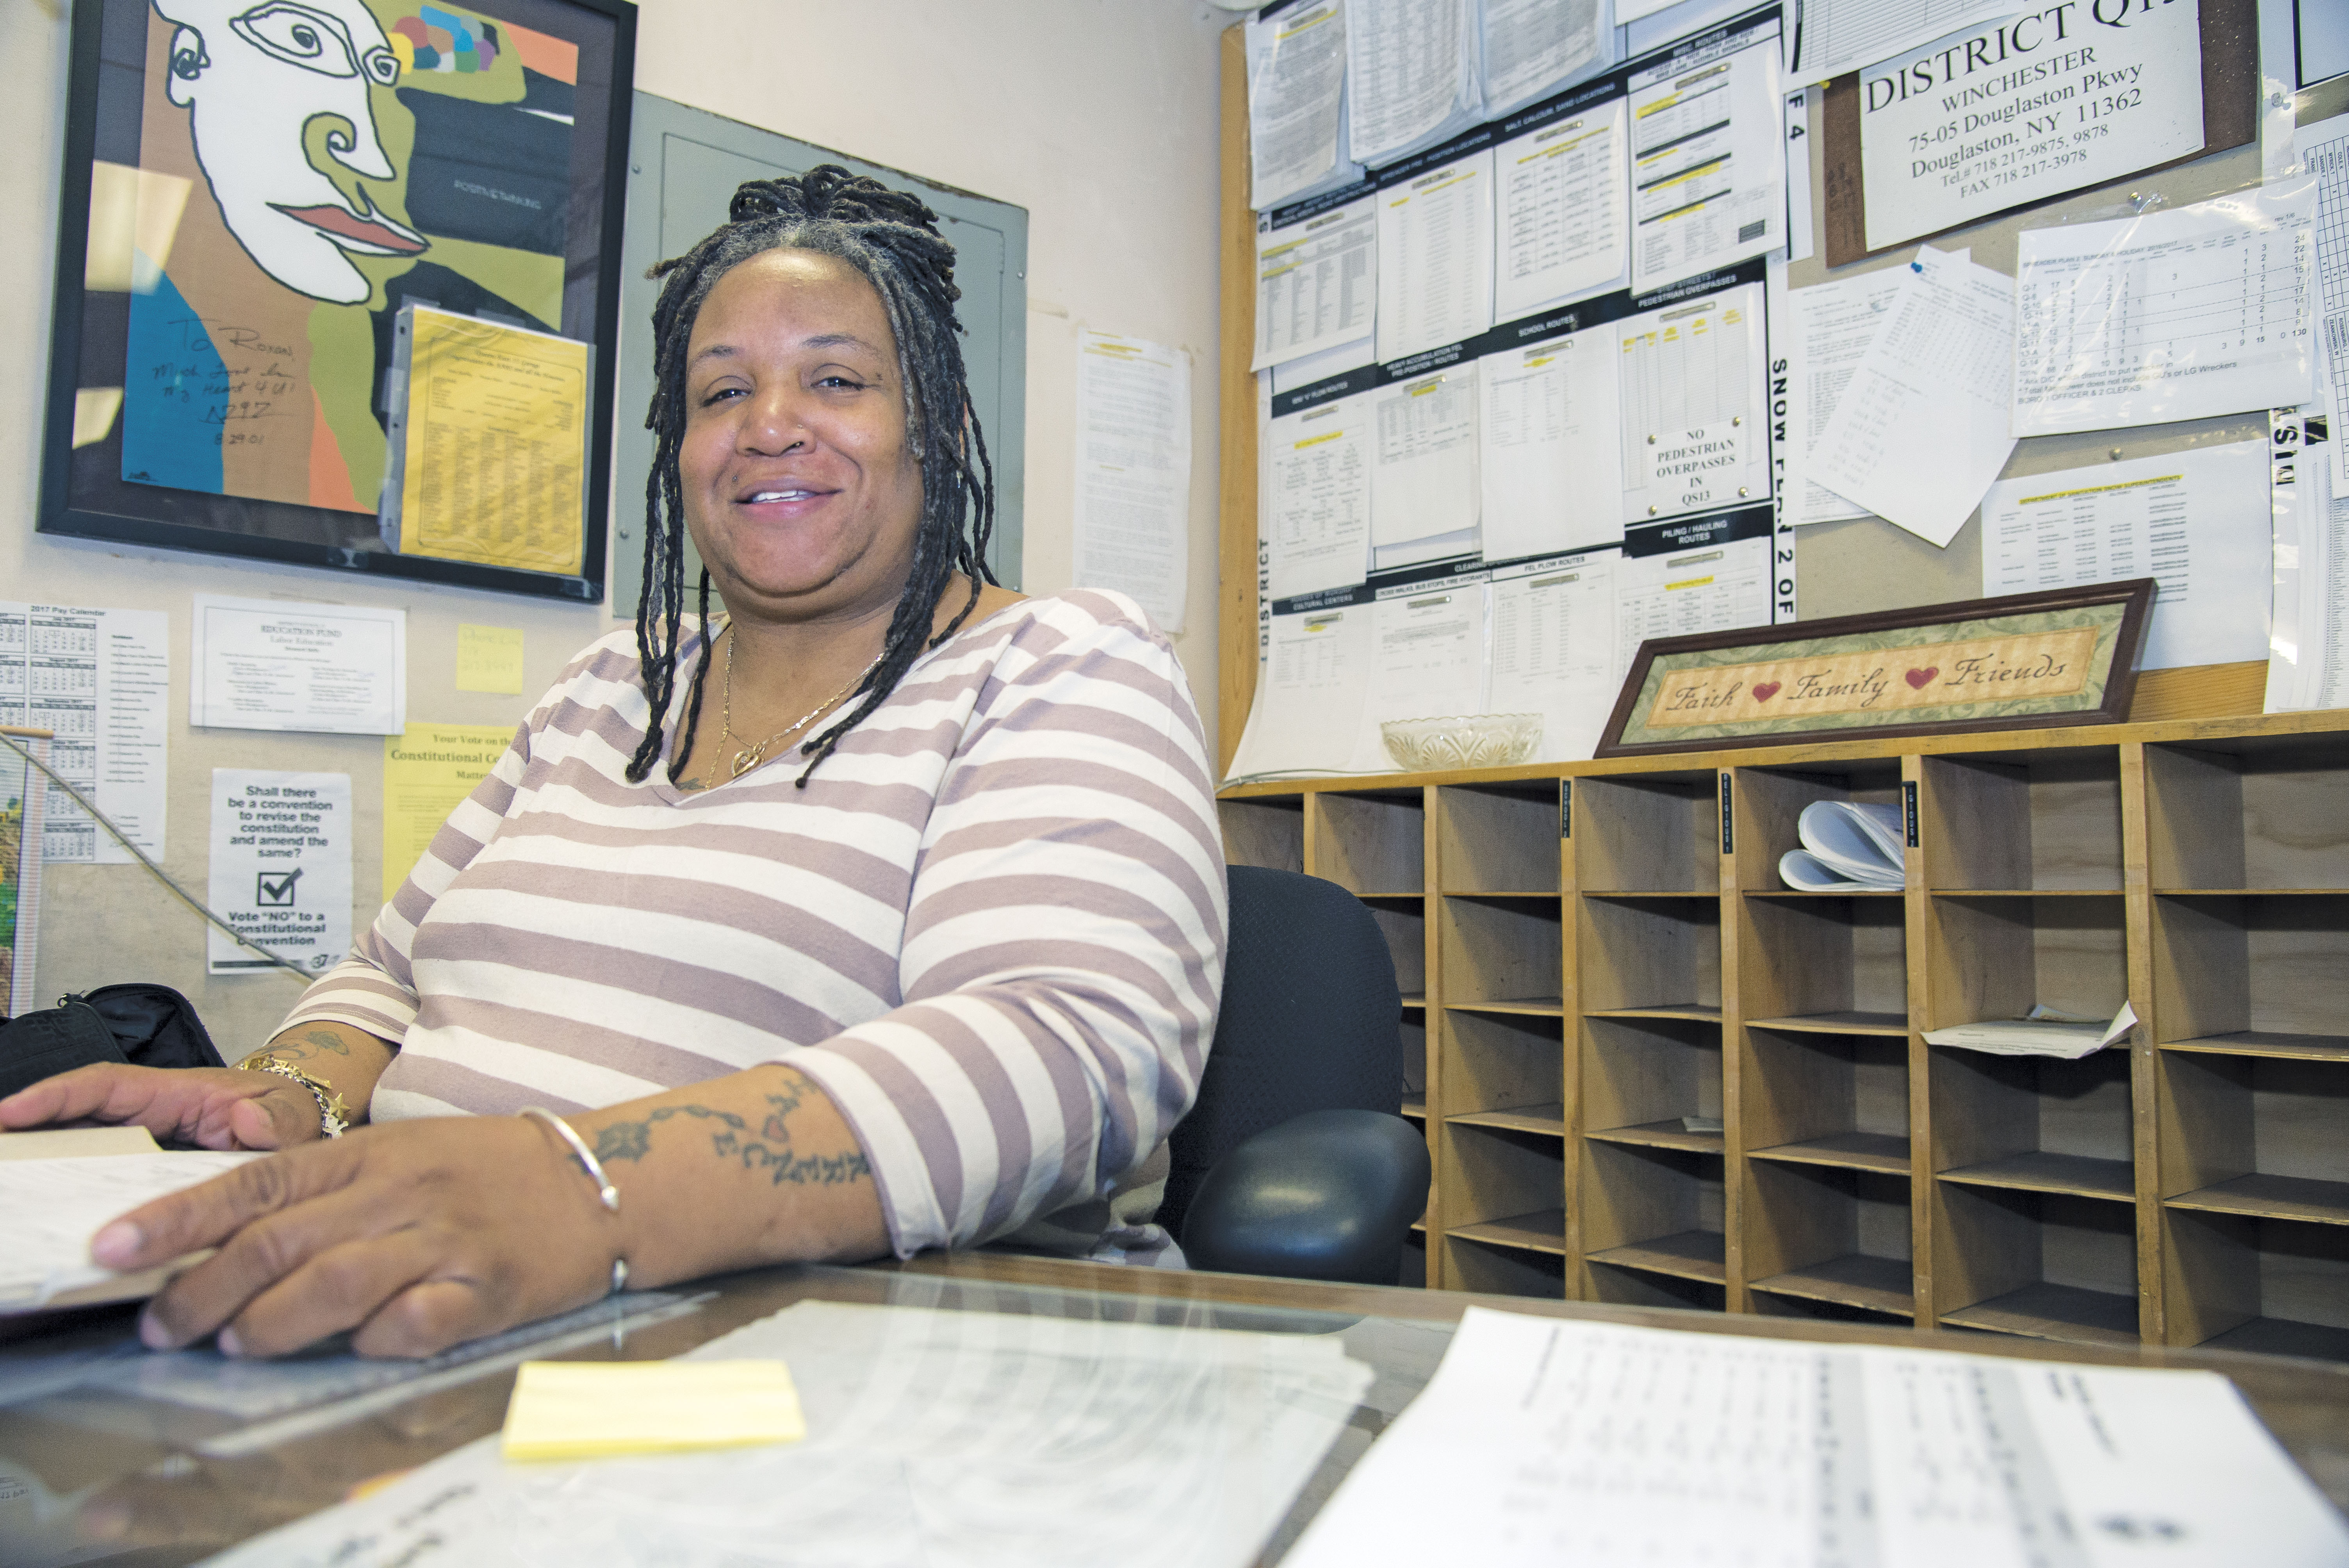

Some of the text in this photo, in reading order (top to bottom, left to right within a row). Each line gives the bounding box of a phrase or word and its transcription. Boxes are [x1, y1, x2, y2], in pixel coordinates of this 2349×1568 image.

[1866, 2, 2076, 113] DISTRICT
[1942, 46, 2098, 113] WINCHESTER
[1575, 82, 1616, 104] LOCATIONS
[1909, 64, 2143, 152] 75-05 Douglaston Pkwy
[1790, 125, 1805, 140] 4
[1911, 88, 2142, 178] Douglaston, NY 11362
[1975, 158, 1998, 177] 718
[2073, 123, 2108, 146] 9878
[1960, 150, 2087, 198] FAX 718 217-3978
[2117, 247, 2144, 256] HOLIDAY
[2295, 245, 2305, 253] 22
[2295, 255, 2304, 264] 14
[1638, 274, 1736, 307] PEDESTRIAN OVERPASSES
[2295, 297, 2304, 305] 14
[1518, 314, 1574, 338] SCHOOL ROUTES
[2292, 328, 2307, 337] 130
[2338, 317, 2347, 349] ROSENBURG,
[1387, 362, 1405, 371] HEAVY
[1434, 353, 1459, 366] ROUTES
[2082, 370, 2106, 379] district
[2118, 367, 2130, 375] put
[2184, 367, 2197, 376] LG
[2199, 362, 2237, 373] Wreckers
[1773, 359, 1788, 441] SNOW
[2052, 390, 2088, 401] OFFICER
[2106, 385, 2141, 395] CLERKS
[1686, 429, 1705, 440] NO
[1657, 439, 1735, 463] PEDESTRIAN
[1656, 455, 1736, 478] OVERPASSES
[1690, 476, 1703, 488] IN
[1681, 490, 1711, 507] QS13
[1662, 520, 1727, 538] PILING HAULING
[1679, 533, 1711, 545] ROUTES
[1538, 560, 1556, 571] PLOW
[1558, 556, 1585, 567] ROUTES
[1778, 549, 1794, 564] 2
[1415, 582, 1426, 590] BUS
[1446, 577, 1458, 585] FIRE
[1460, 573, 1490, 583] HYDRANTS
[1259, 539, 1270, 647] DISTRICT
[1778, 579, 1794, 613] OF
[1324, 595, 1354, 606] CENTERS
[52, 607, 67, 615] Pay
[70, 608, 106, 617] Calendar
[261, 625, 342, 638] EDUCATION FUND
[1665, 653, 2067, 711] Faith Family Friends
[433, 734, 460, 743] Your
[463, 735, 483, 745] Vote
[391, 749, 483, 764] Constitutional
[246, 785, 317, 798] Shall there
[228, 798, 333, 811] be a convention
[239, 811, 321, 823] to revise the
[241, 823, 319, 834] constitution
[230, 836, 329, 847] and amend the
[258, 848, 302, 858] same?
[228, 912, 260, 922] Vote
[298, 912, 312, 921] to
[237, 935, 316, 946] Cnvention
